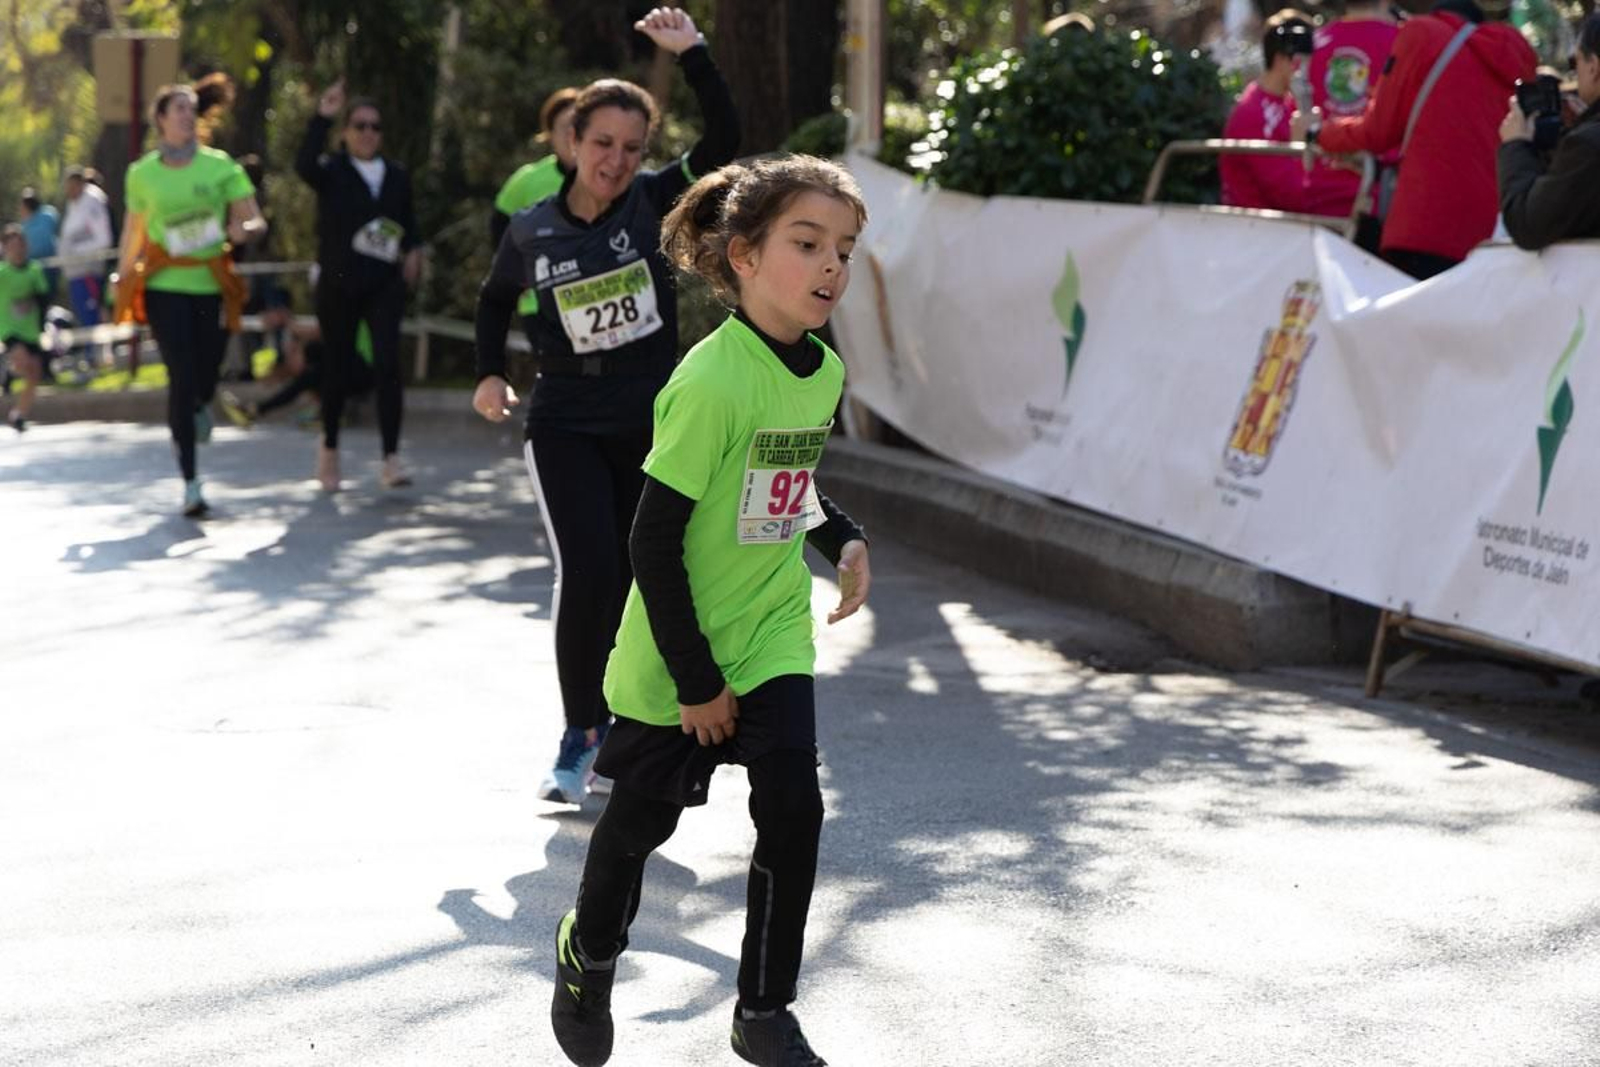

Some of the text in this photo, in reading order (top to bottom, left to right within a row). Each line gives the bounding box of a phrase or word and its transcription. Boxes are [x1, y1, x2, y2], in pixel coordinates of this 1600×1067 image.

[585, 295, 639, 334] 228
[774, 434, 790, 448] SAN
[767, 470, 810, 515] 92
[1529, 527, 1575, 557] Municipal
[1576, 539, 1589, 560] de
[1483, 546, 1530, 576] Deportes
[1531, 560, 1545, 579] de
